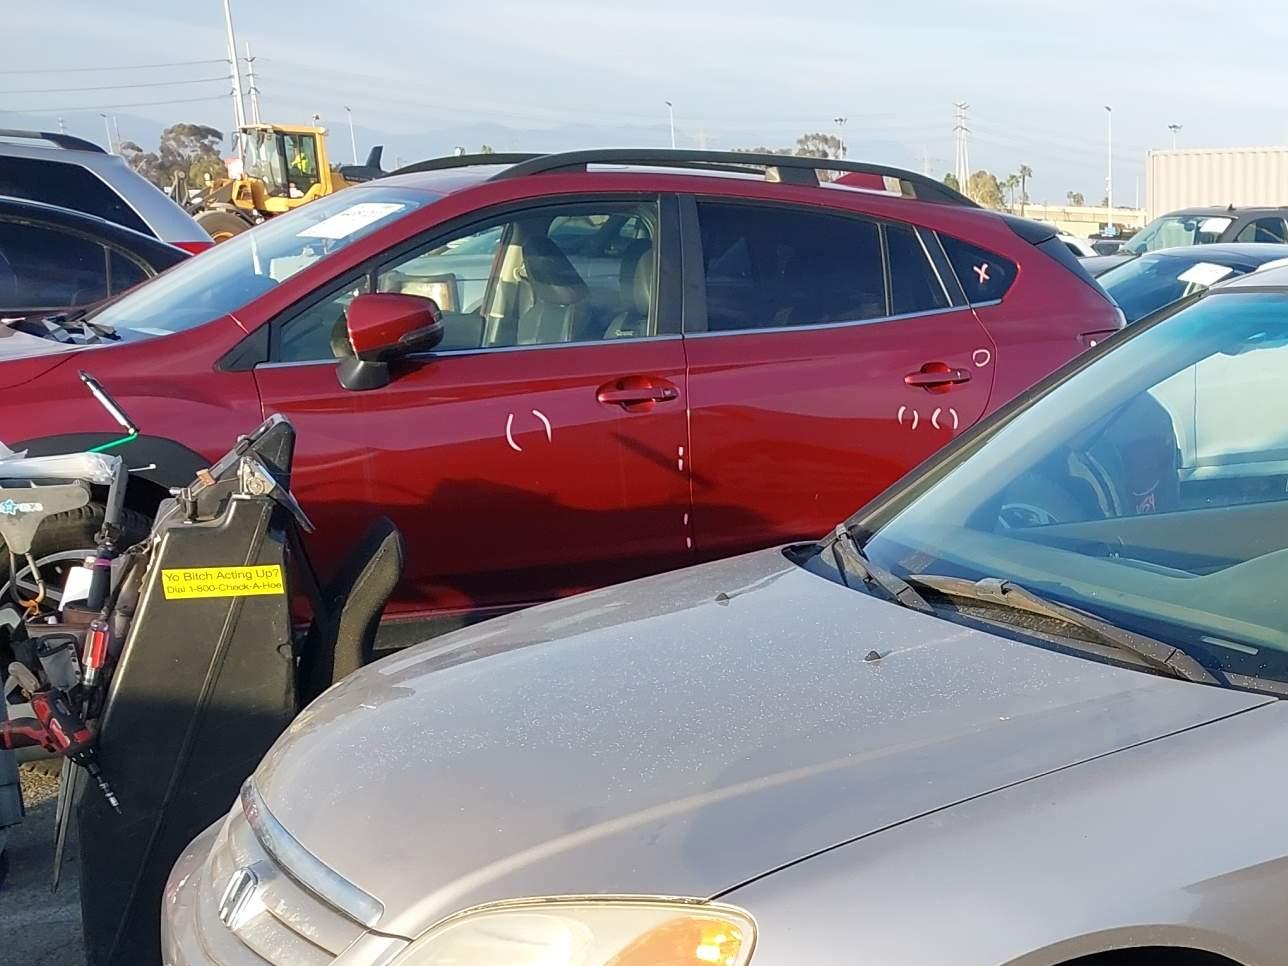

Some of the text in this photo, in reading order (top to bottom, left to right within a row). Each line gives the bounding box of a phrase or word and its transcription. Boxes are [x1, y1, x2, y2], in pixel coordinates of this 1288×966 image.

[165, 568, 280, 582] Yo Bitch Acting Up?
